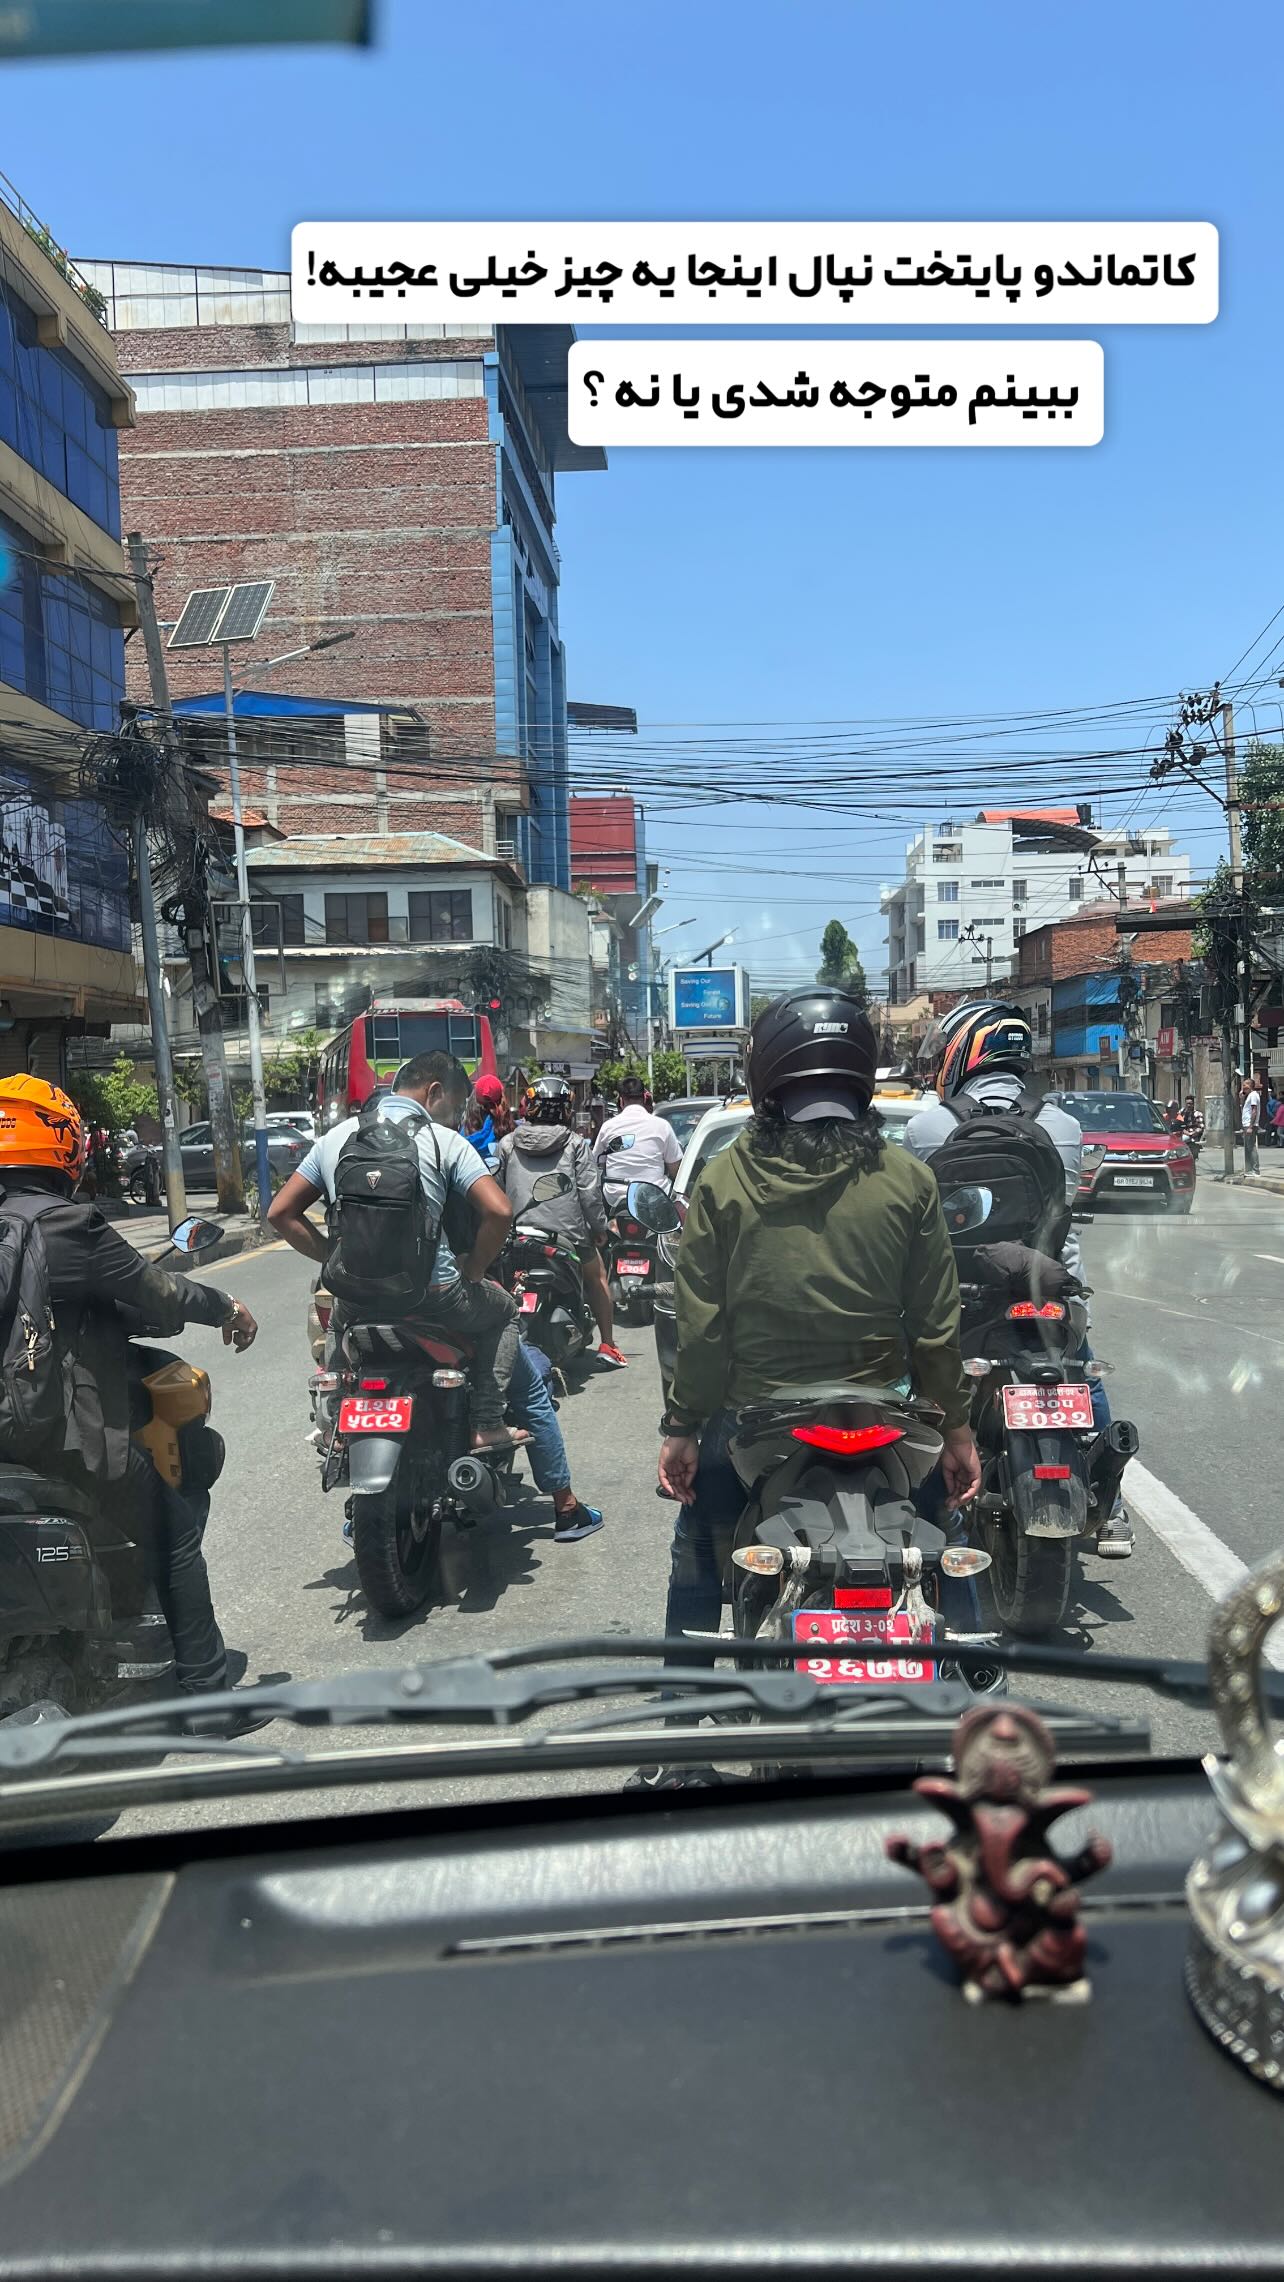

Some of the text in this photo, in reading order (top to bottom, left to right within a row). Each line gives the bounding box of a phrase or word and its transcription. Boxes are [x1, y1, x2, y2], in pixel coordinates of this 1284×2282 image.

[680, 1001, 700, 1009] Saving
[347, 1414, 403, 1429] ५८८२
[1010, 1411, 1088, 1427] ३०२२
[36, 1546, 69, 1562] 125
[831, 1617, 895, 1633] प्रदेश ३-०२
[807, 1659, 924, 1679] २६७७
